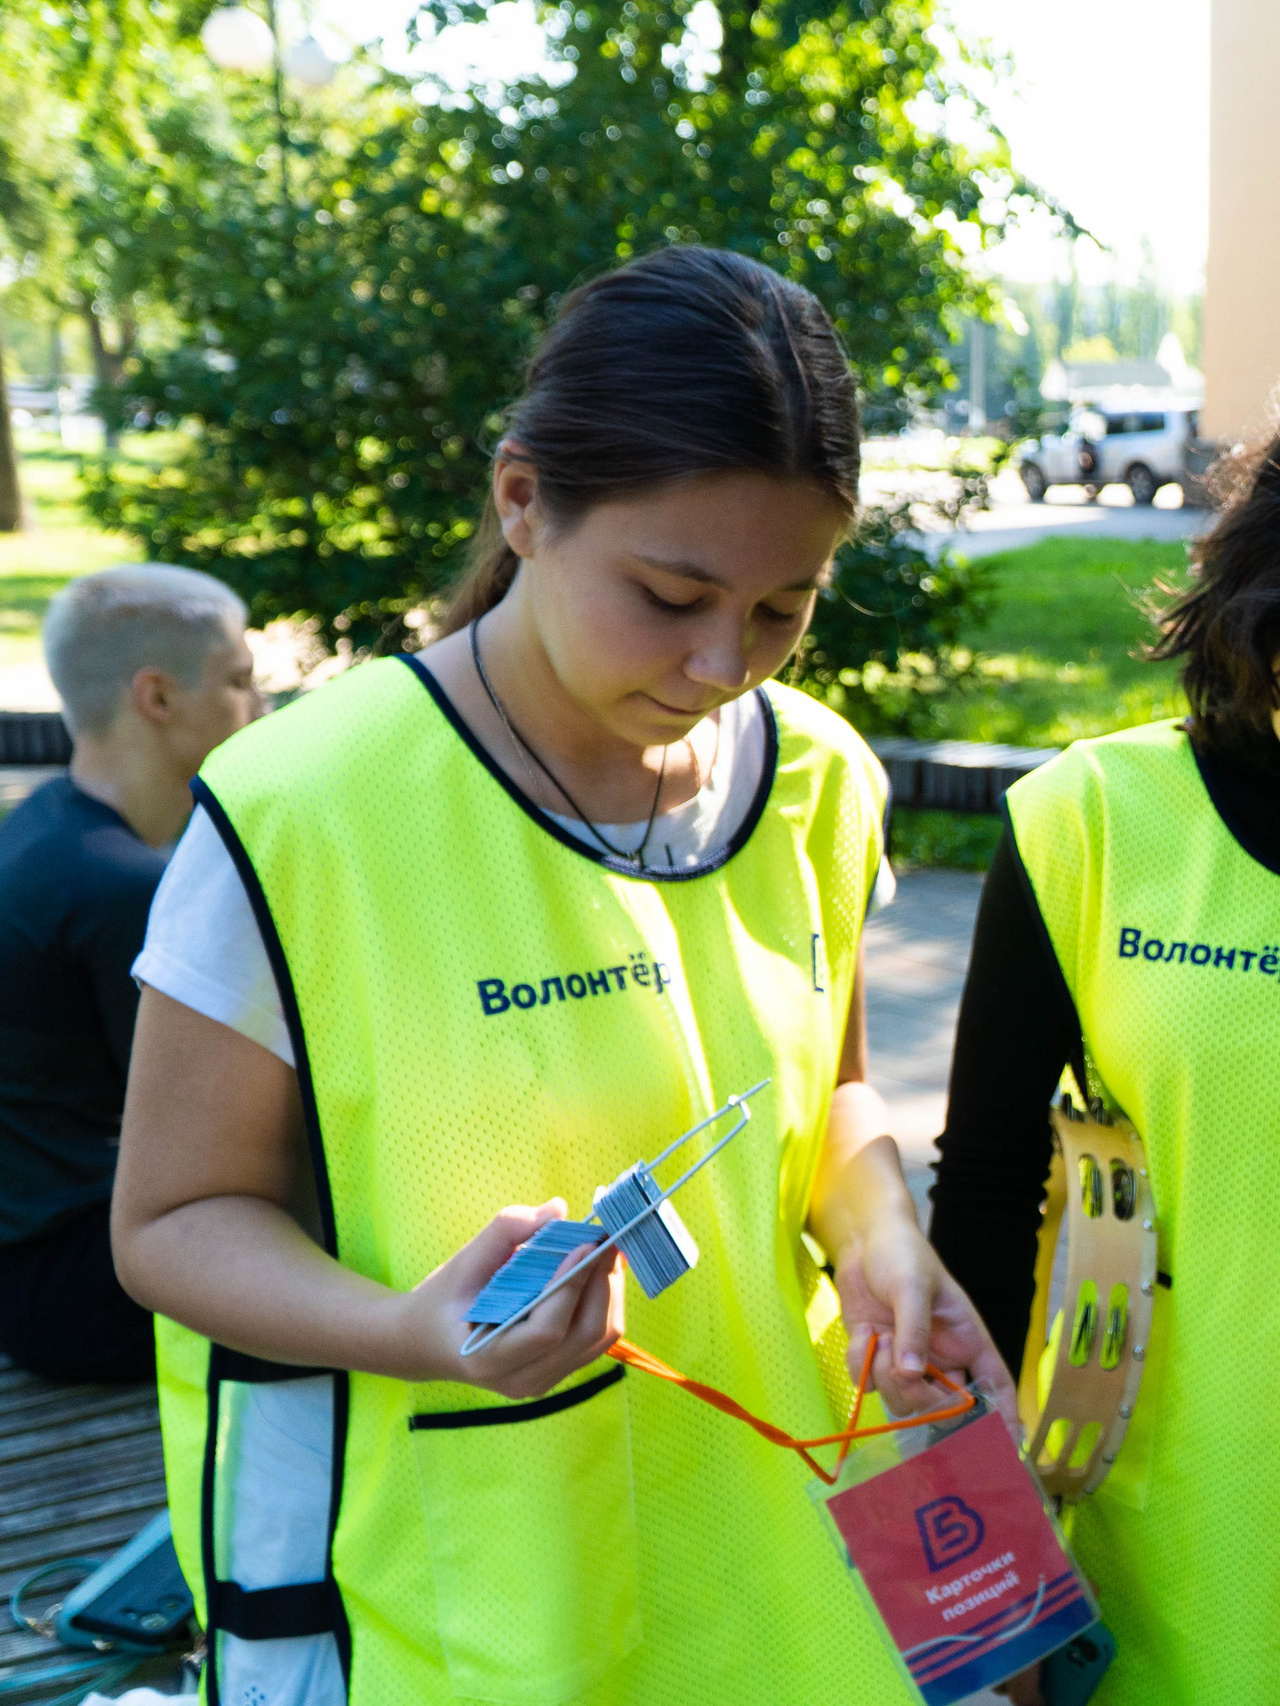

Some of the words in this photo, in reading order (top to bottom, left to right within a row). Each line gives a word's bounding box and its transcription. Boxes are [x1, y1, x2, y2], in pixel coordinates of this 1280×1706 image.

[477, 951, 671, 1016] Волонтёр
[925, 1551, 1016, 1604] Карточки
[941, 1570, 1019, 1622] позиций
